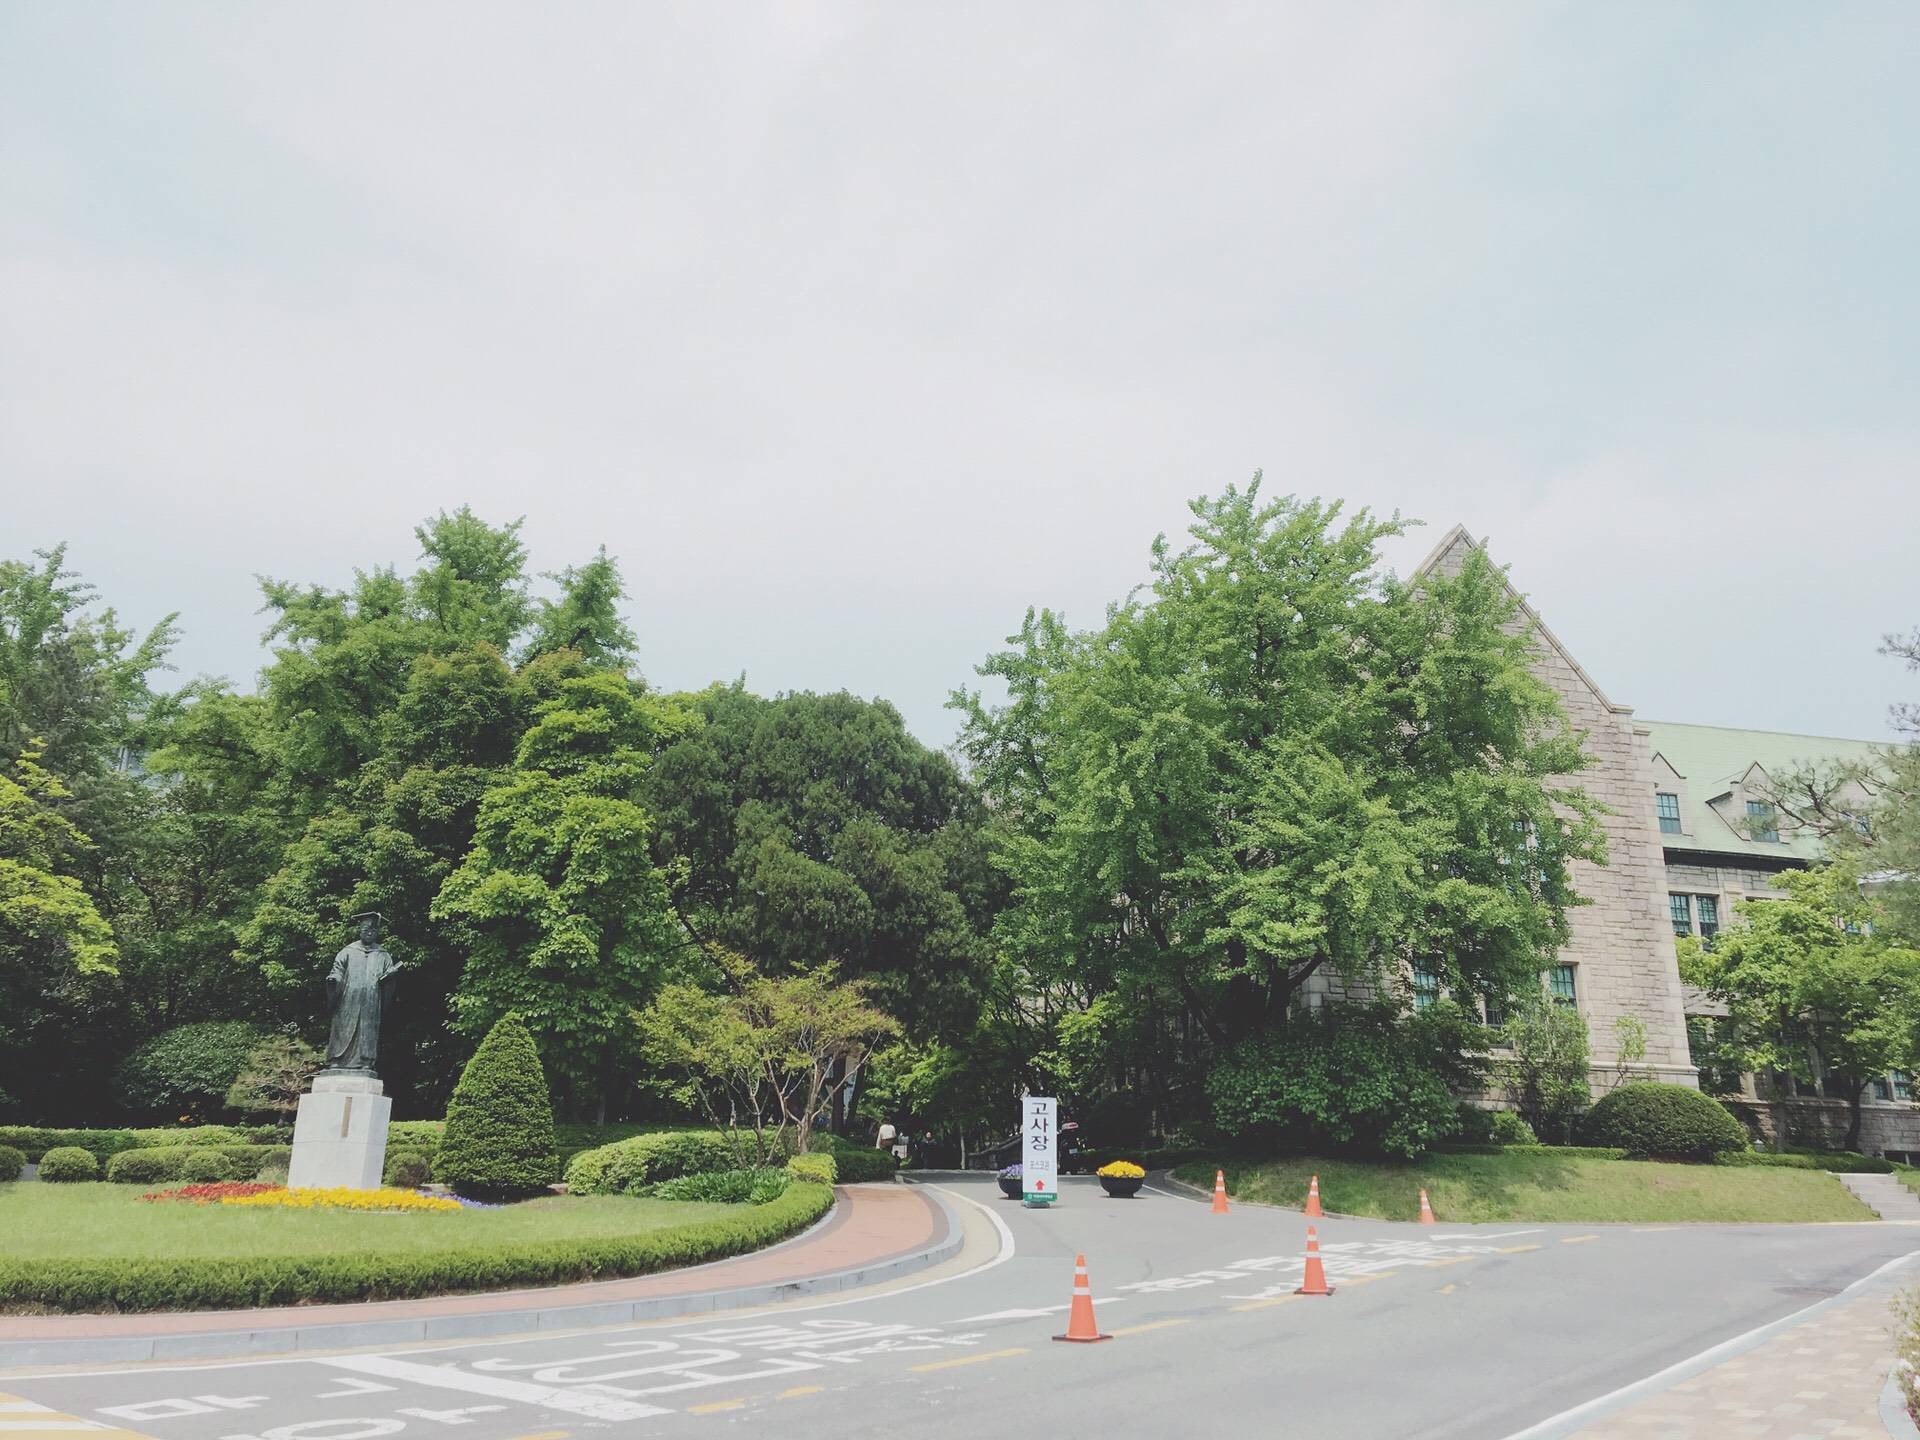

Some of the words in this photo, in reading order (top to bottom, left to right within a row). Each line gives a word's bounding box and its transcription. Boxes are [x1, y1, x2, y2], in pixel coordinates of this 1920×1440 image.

[1030, 1102, 1049, 1151] 고사장
[672, 1319, 988, 1363] 주차장
[471, 1339, 826, 1399] ECC
